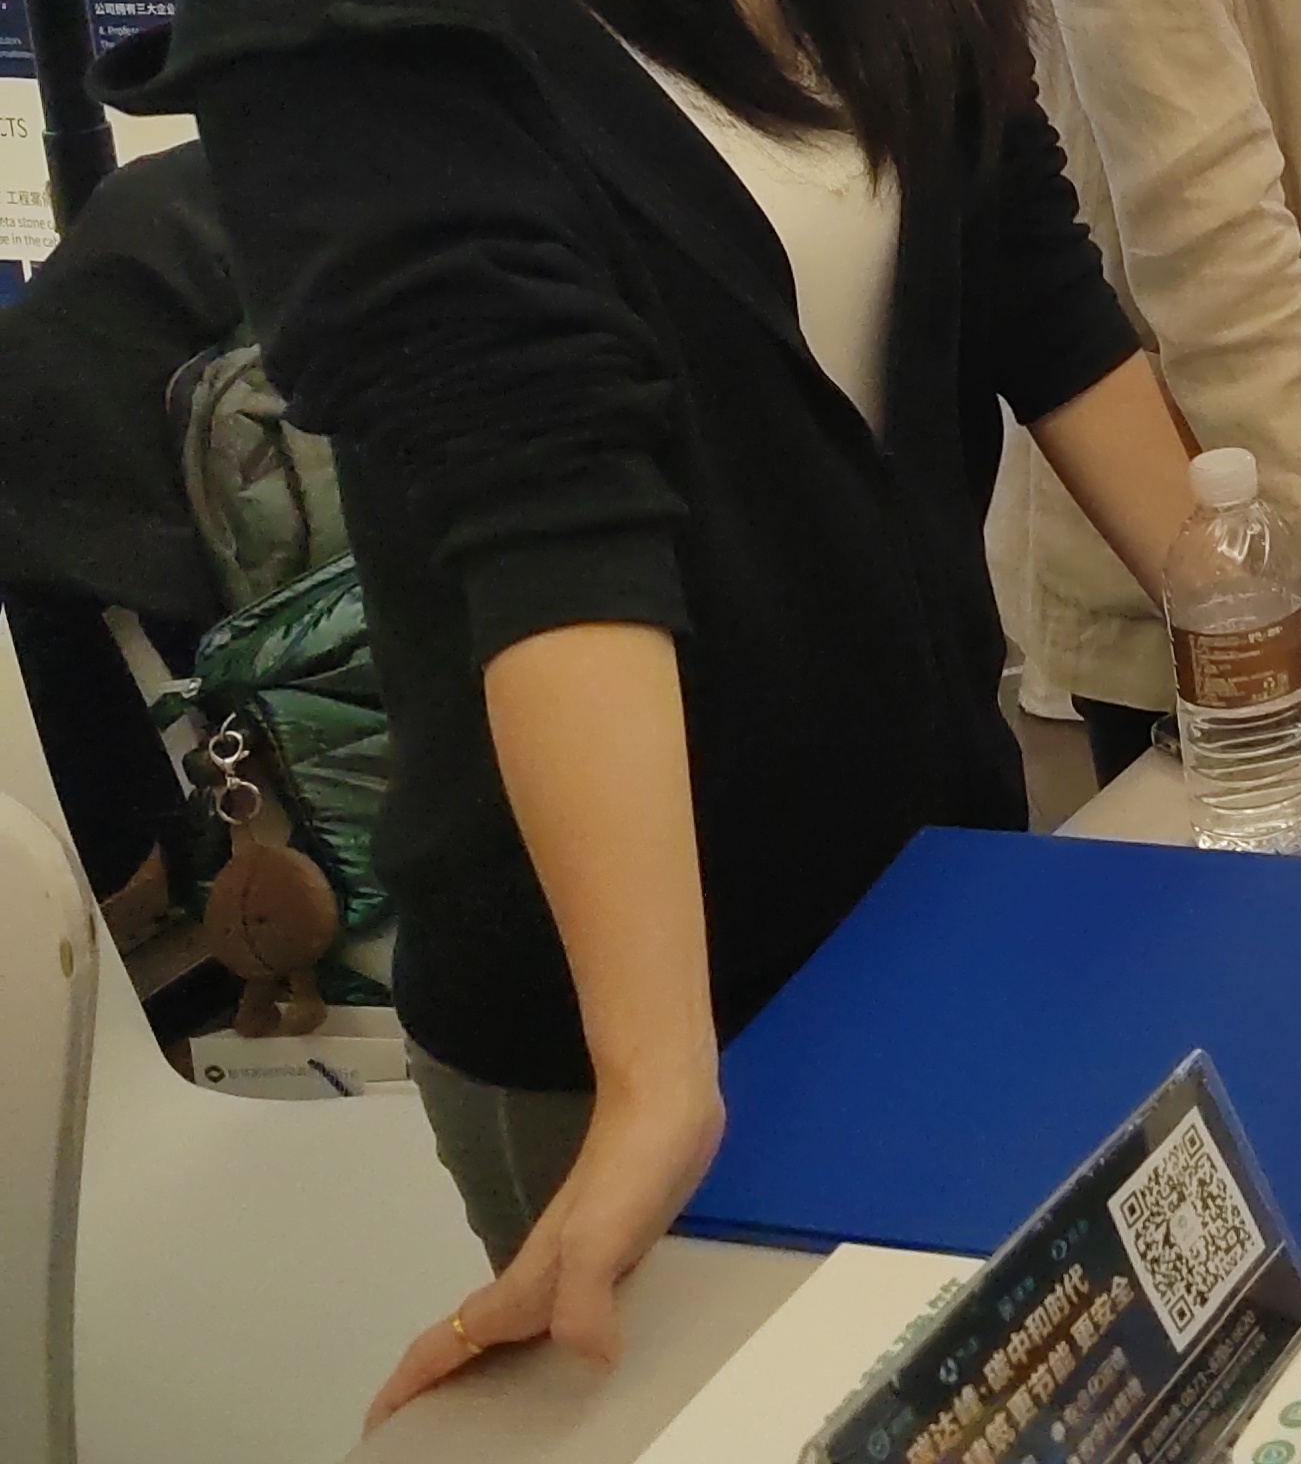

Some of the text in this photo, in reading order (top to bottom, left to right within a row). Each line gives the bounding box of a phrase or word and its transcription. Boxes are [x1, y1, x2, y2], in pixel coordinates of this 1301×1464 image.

[18, 217, 45, 229] stone
[12, 233, 22, 245] in
[24, 234, 41, 247] the
